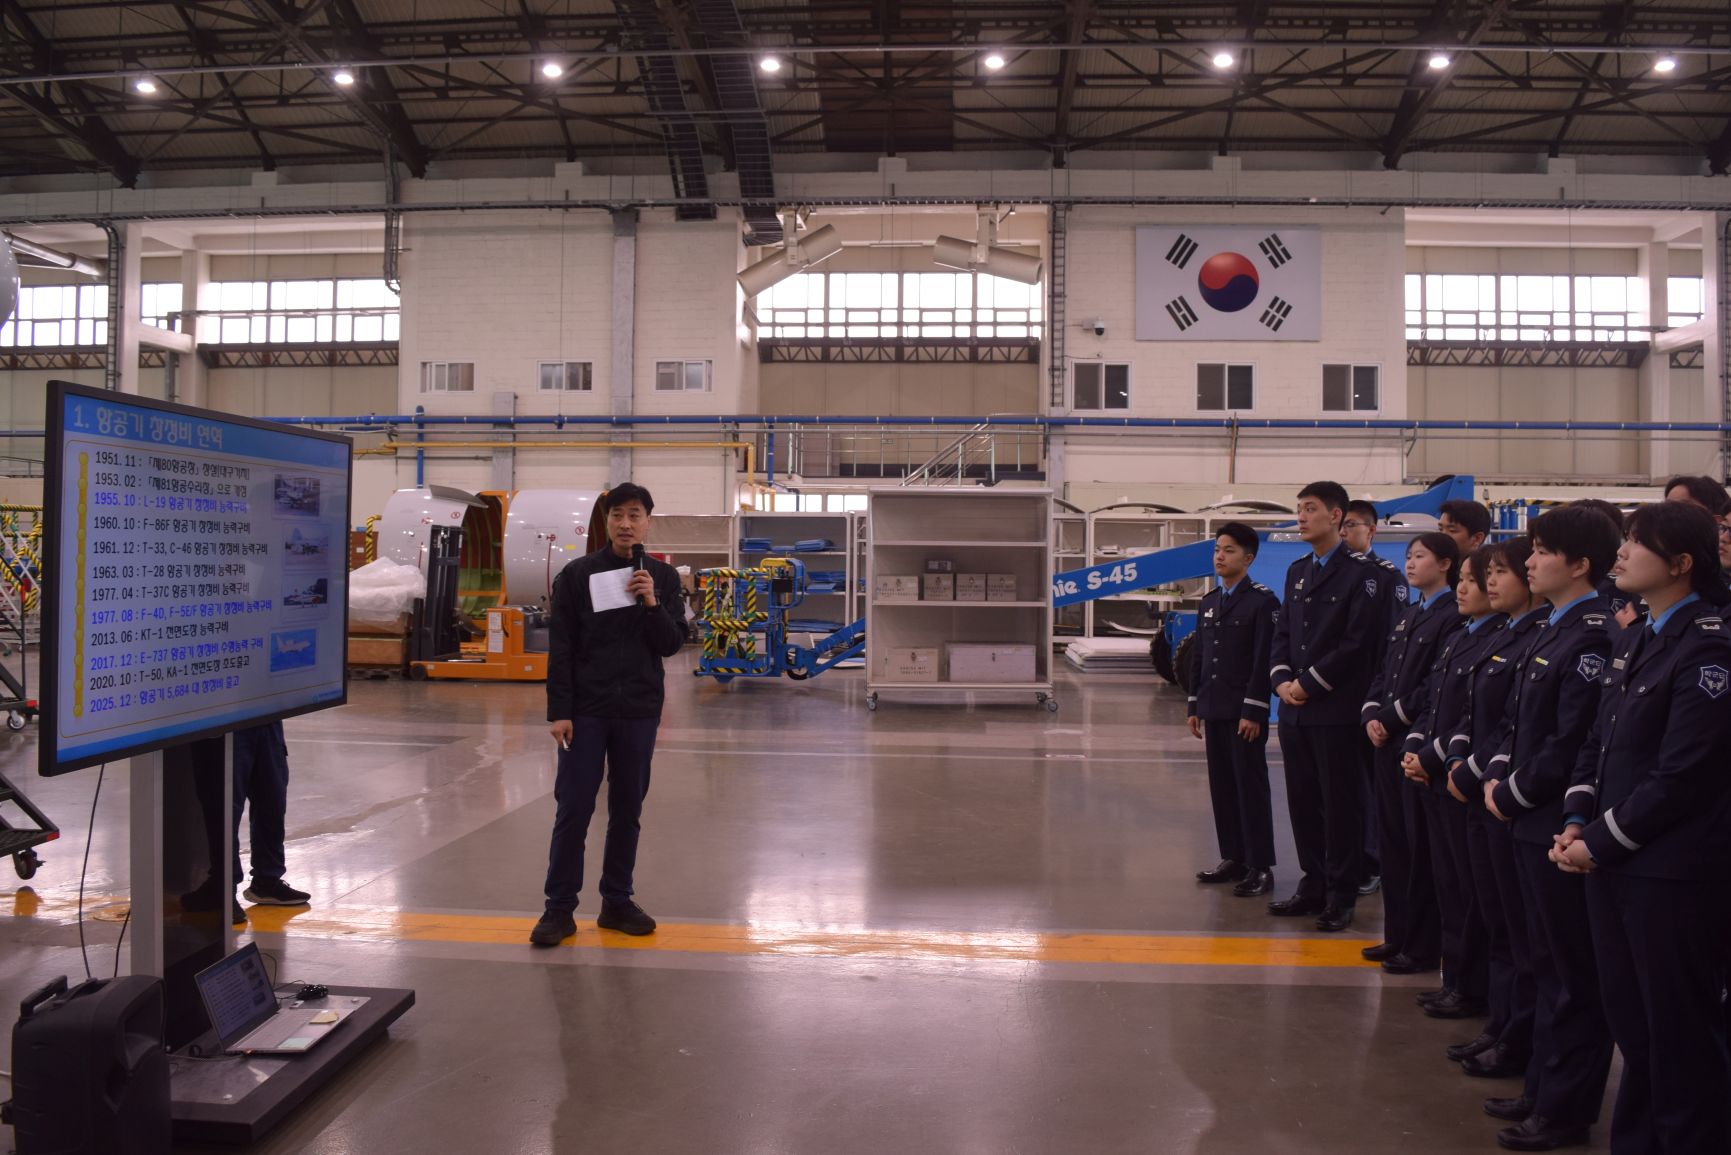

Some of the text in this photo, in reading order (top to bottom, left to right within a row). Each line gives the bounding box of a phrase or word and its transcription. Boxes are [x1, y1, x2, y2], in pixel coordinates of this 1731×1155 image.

[73, 404, 89, 428] 1.
[95, 451, 121, 465] 1951.
[125, 454, 135, 466] 11
[95, 472, 121, 485] 1953.
[124, 475, 135, 487] 02
[94, 492, 121, 505] 1955.
[123, 494, 135, 506] 10
[143, 495, 166, 508] L-19
[93, 517, 120, 529] 1960.
[123, 517, 134, 529] 10
[142, 518, 169, 530] F-86F
[92, 541, 120, 553] 1961.
[122, 542, 134, 553] 12
[169, 542, 191, 553] C-46
[92, 565, 119, 578] 1963.
[122, 565, 134, 577] 03
[142, 565, 164, 577] T-28
[1087, 562, 1138, 590] S-45
[91, 588, 118, 601] 1977.
[121, 587, 133, 599] 04
[141, 585, 169, 598] T-37C
[91, 610, 118, 624] 1977.
[121, 608, 133, 622] 08
[91, 631, 118, 646] 2013.
[120, 629, 132, 642] 06
[90, 655, 117, 670] 2017.
[120, 653, 132, 666] 12
[90, 674, 117, 690] 2020.
[119, 672, 131, 685] 10
[166, 664, 187, 678] KA-1
[90, 696, 116, 712] 2025.
[119, 693, 131, 707] 12
